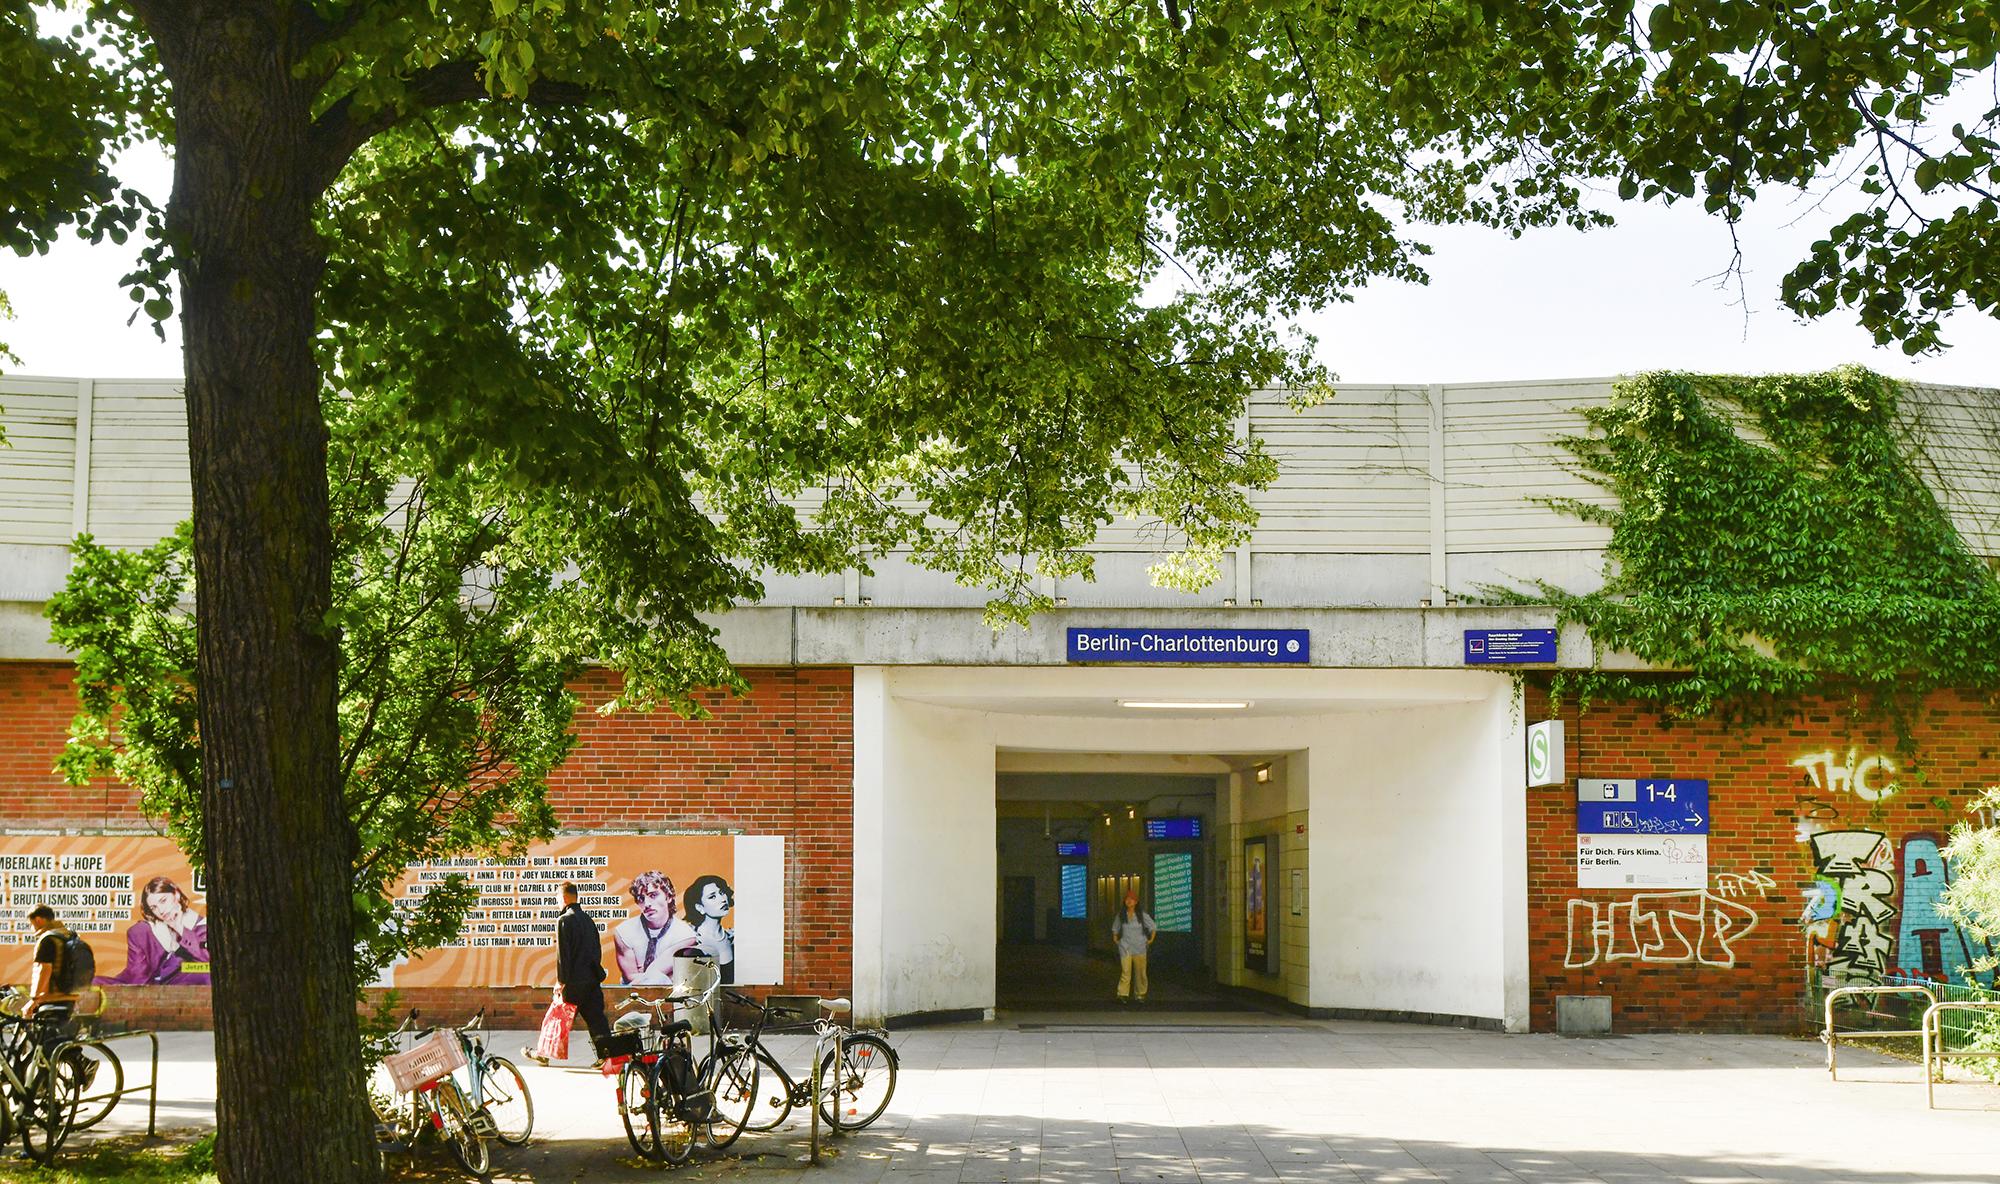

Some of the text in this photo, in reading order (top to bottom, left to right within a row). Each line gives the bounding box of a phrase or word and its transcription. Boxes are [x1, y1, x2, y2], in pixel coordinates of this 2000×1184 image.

[1077, 634, 1279, 656] Berlin-Charlottenburg
[1532, 733, 1547, 776] S
[1794, 749, 1896, 801] THC
[1646, 783, 1677, 802] 1-4
[1580, 848, 1661, 856] Für Dich. Fürs Klima.
[62, 857, 103, 870] J-HOPE
[454, 858, 478, 866] AMBOR
[533, 857, 552, 866] BUNT.
[560, 857, 577, 866] NORA
[580, 857, 587, 865] EN
[589, 857, 606, 865] PURE
[1580, 858, 1621, 866] Für Berlin.
[420, 871, 437, 880] MISS
[477, 871, 494, 879] ANNA
[502, 871, 515, 879] FLO
[522, 871, 538, 879] JOEY
[540, 870, 568, 879] VALENCE
[570, 870, 575, 878] &
[577, 870, 594, 878] BRAE
[13, 875, 39, 888] RAYE
[50, 875, 91, 888] BENSON
[94, 875, 130, 888] BOONE
[410, 885, 423, 893] NEIL
[485, 884, 501, 893] CLUB
[503, 884, 512, 892] NF
[519, 884, 545, 892] CA7RIEL
[548, 884, 552, 892] &
[13, 894, 79, 906] BRUTALISMUS
[81, 894, 108, 905] 3000
[117, 894, 132, 906] IVE
[481, 897, 513, 906] INGROSSO
[521, 897, 542, 905] WASIA
[579, 896, 601, 905] ALESSI
[604, 896, 620, 905] ROSE
[62, 910, 89, 918] SUMMIT
[97, 910, 129, 919] ARTEMAS
[492, 911, 513, 919] RITTER
[515, 911, 531, 919] LEAN
[99, 923, 112, 931] BAY
[477, 924, 495, 933] MICO
[503, 924, 529, 932] ALMOST
[531, 924, 556, 932] MONDA
[473, 938, 490, 946] LAST
[491, 938, 509, 946] TRAIN
[518, 937, 535, 946] KAPA
[536, 937, 551, 946] TULT
